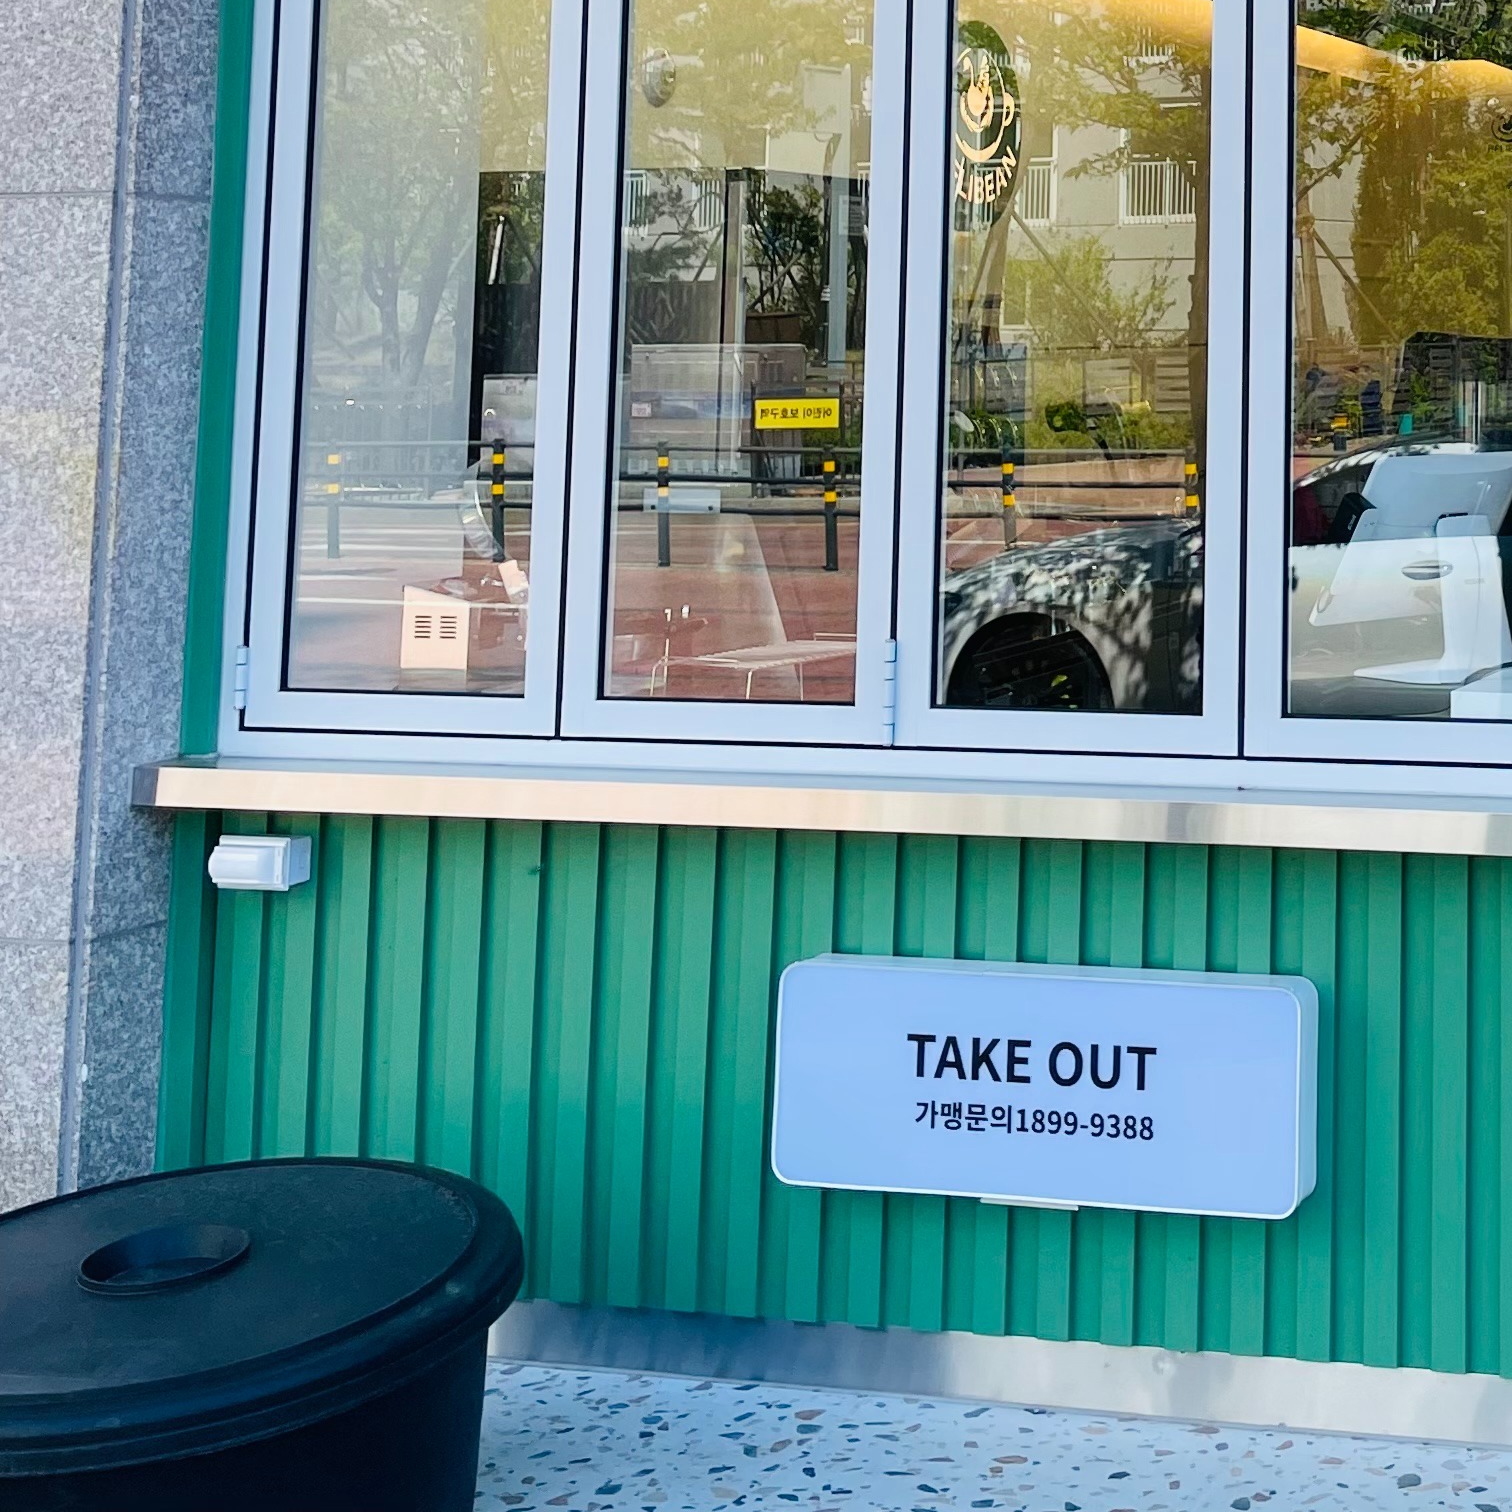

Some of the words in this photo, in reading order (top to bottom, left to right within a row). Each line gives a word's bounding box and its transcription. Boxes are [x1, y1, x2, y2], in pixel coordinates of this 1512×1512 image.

[906, 1033, 1032, 1084] TAKE
[1048, 1041, 1158, 1091] OUT
[914, 1099, 1155, 1141] 가맹문의1899-9388
